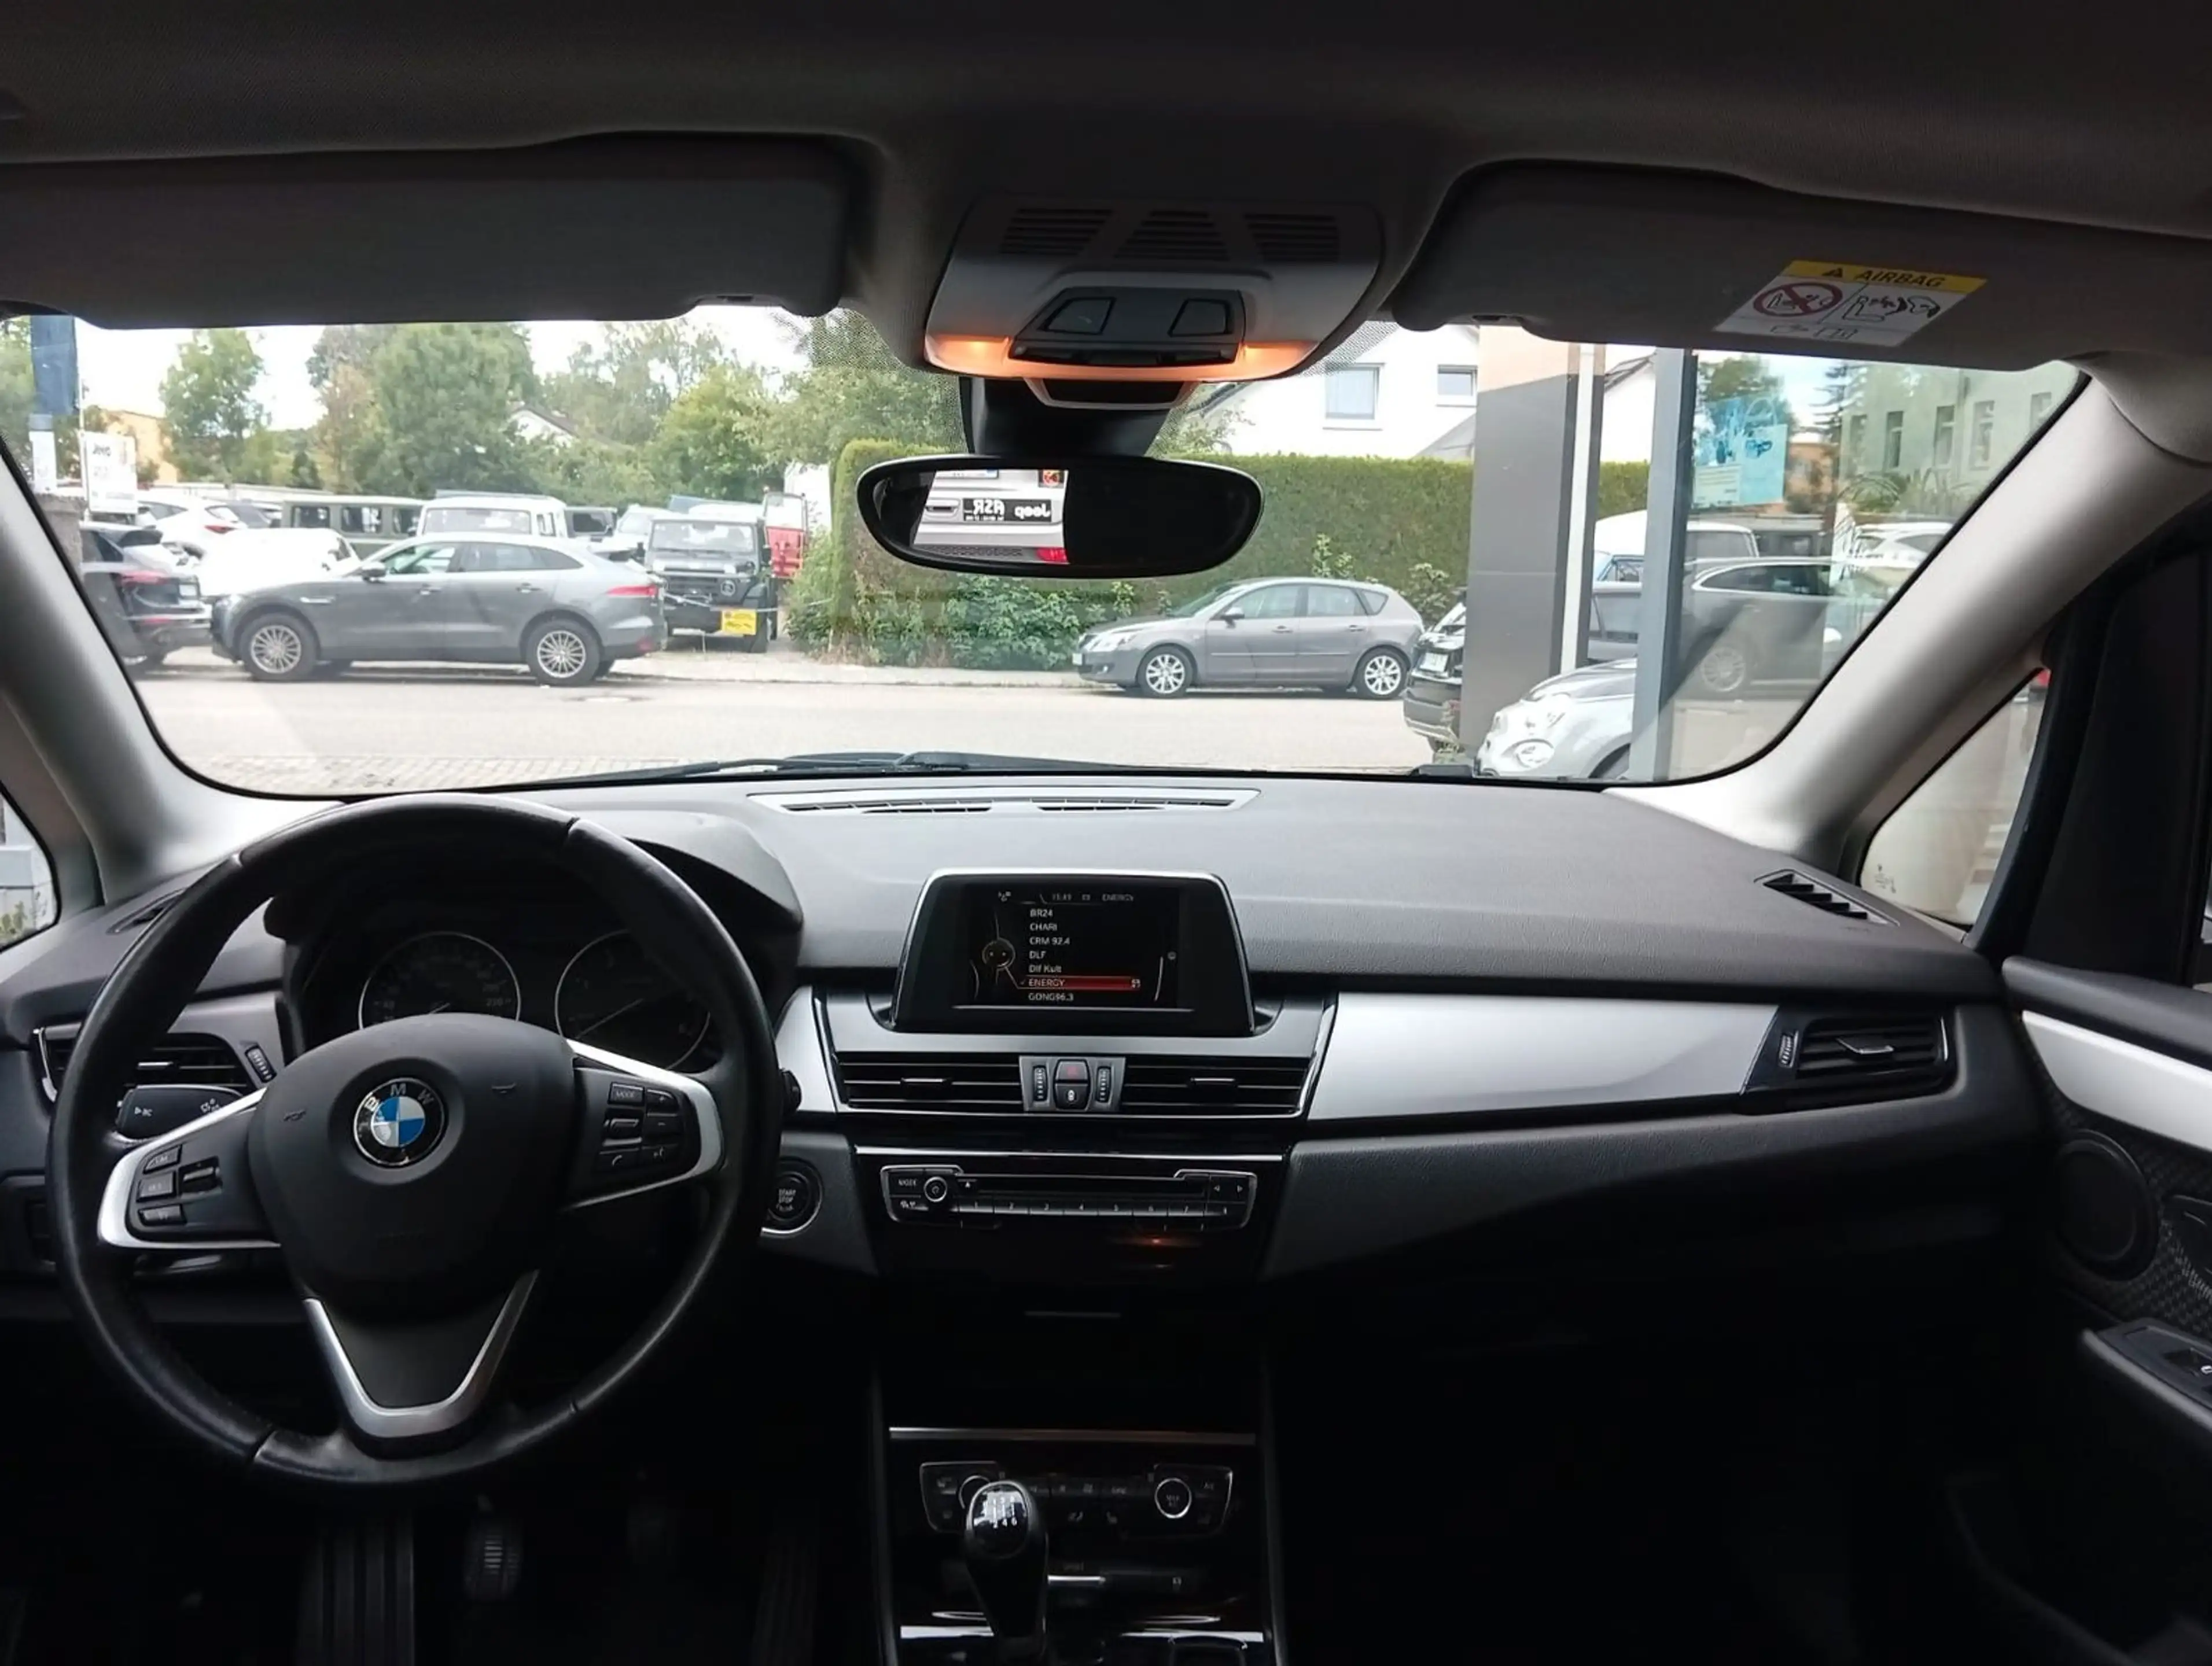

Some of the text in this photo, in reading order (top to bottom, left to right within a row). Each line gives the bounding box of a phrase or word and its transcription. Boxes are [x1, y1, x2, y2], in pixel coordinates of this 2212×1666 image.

[1855, 270, 1946, 288] AIRBAG
[1029, 908, 1053, 918] BR24
[1029, 937, 1070, 945] CRM 92.4
[1029, 950, 1047, 960] DLF
[1028, 978, 1066, 987] ENERGY
[1028, 993, 1074, 1001] GONG96.3
[363, 1082, 435, 1112] BMW
